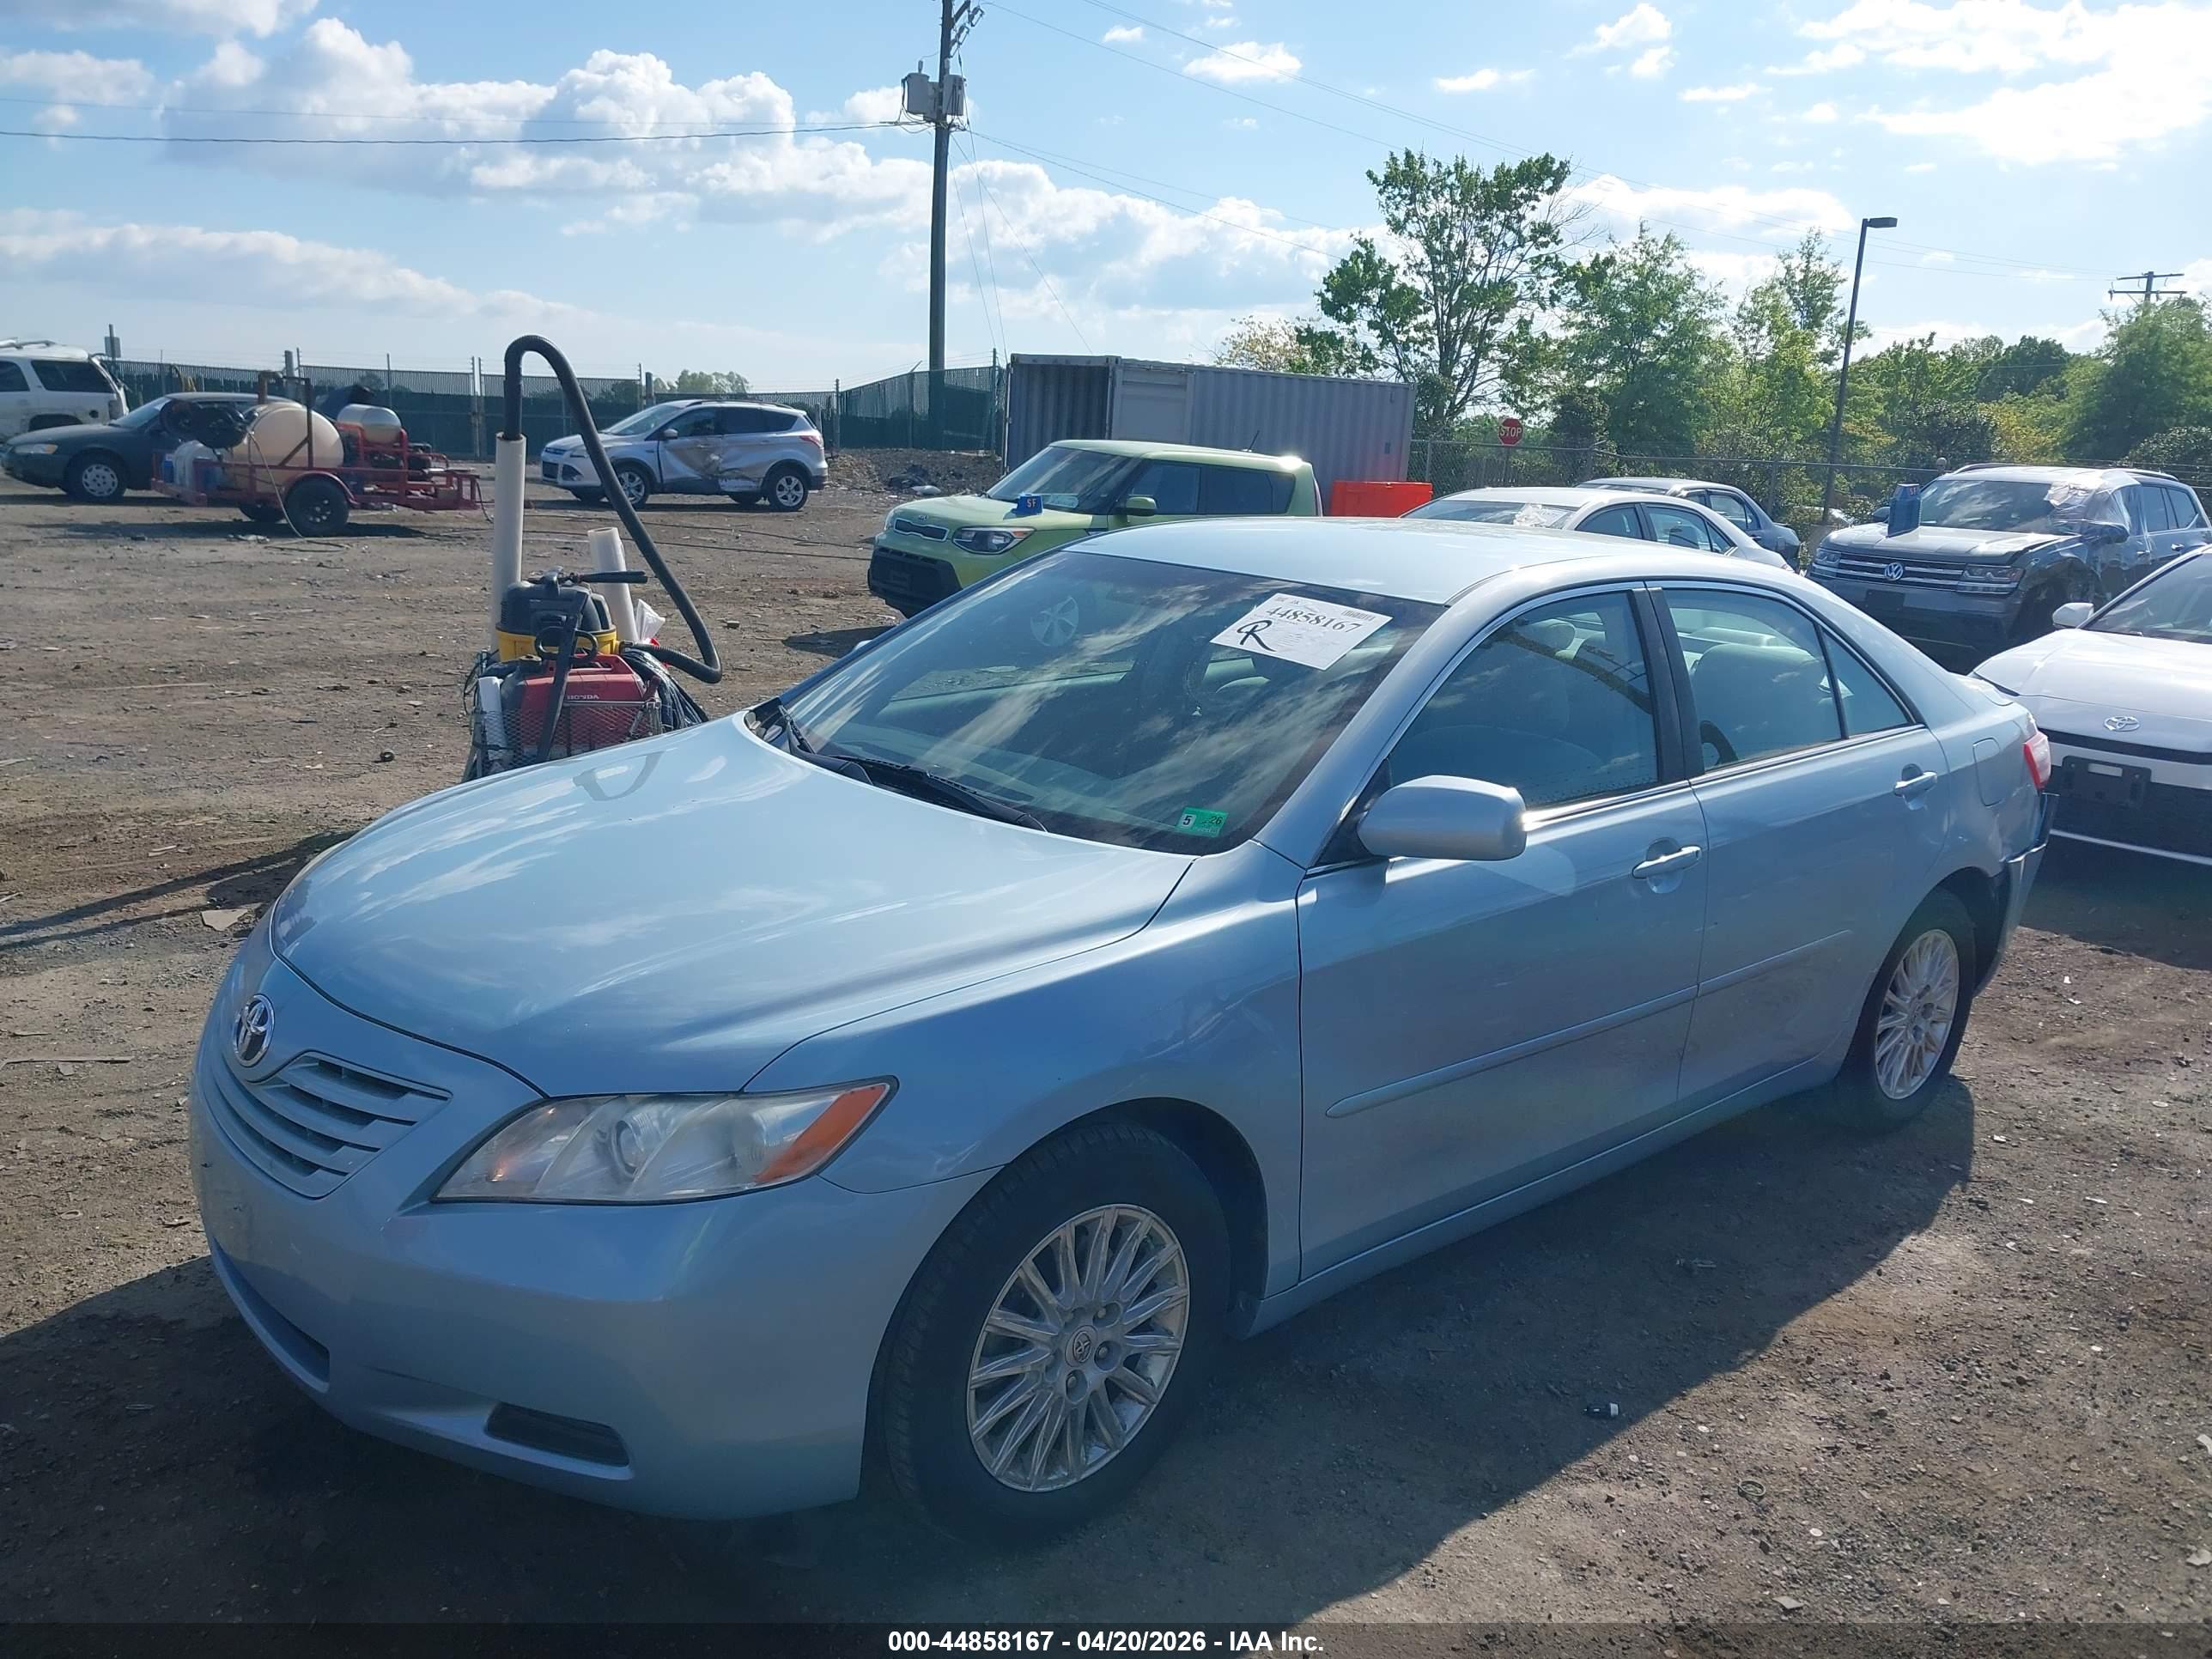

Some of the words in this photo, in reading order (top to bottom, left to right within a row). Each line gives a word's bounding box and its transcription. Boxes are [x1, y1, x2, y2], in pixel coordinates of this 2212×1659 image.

[1499, 426, 1522, 437] STOP
[1026, 498, 1037, 508] SF
[1266, 606, 1363, 633] 44858167
[1237, 619, 1278, 653] R
[1182, 815, 1193, 826] 5
